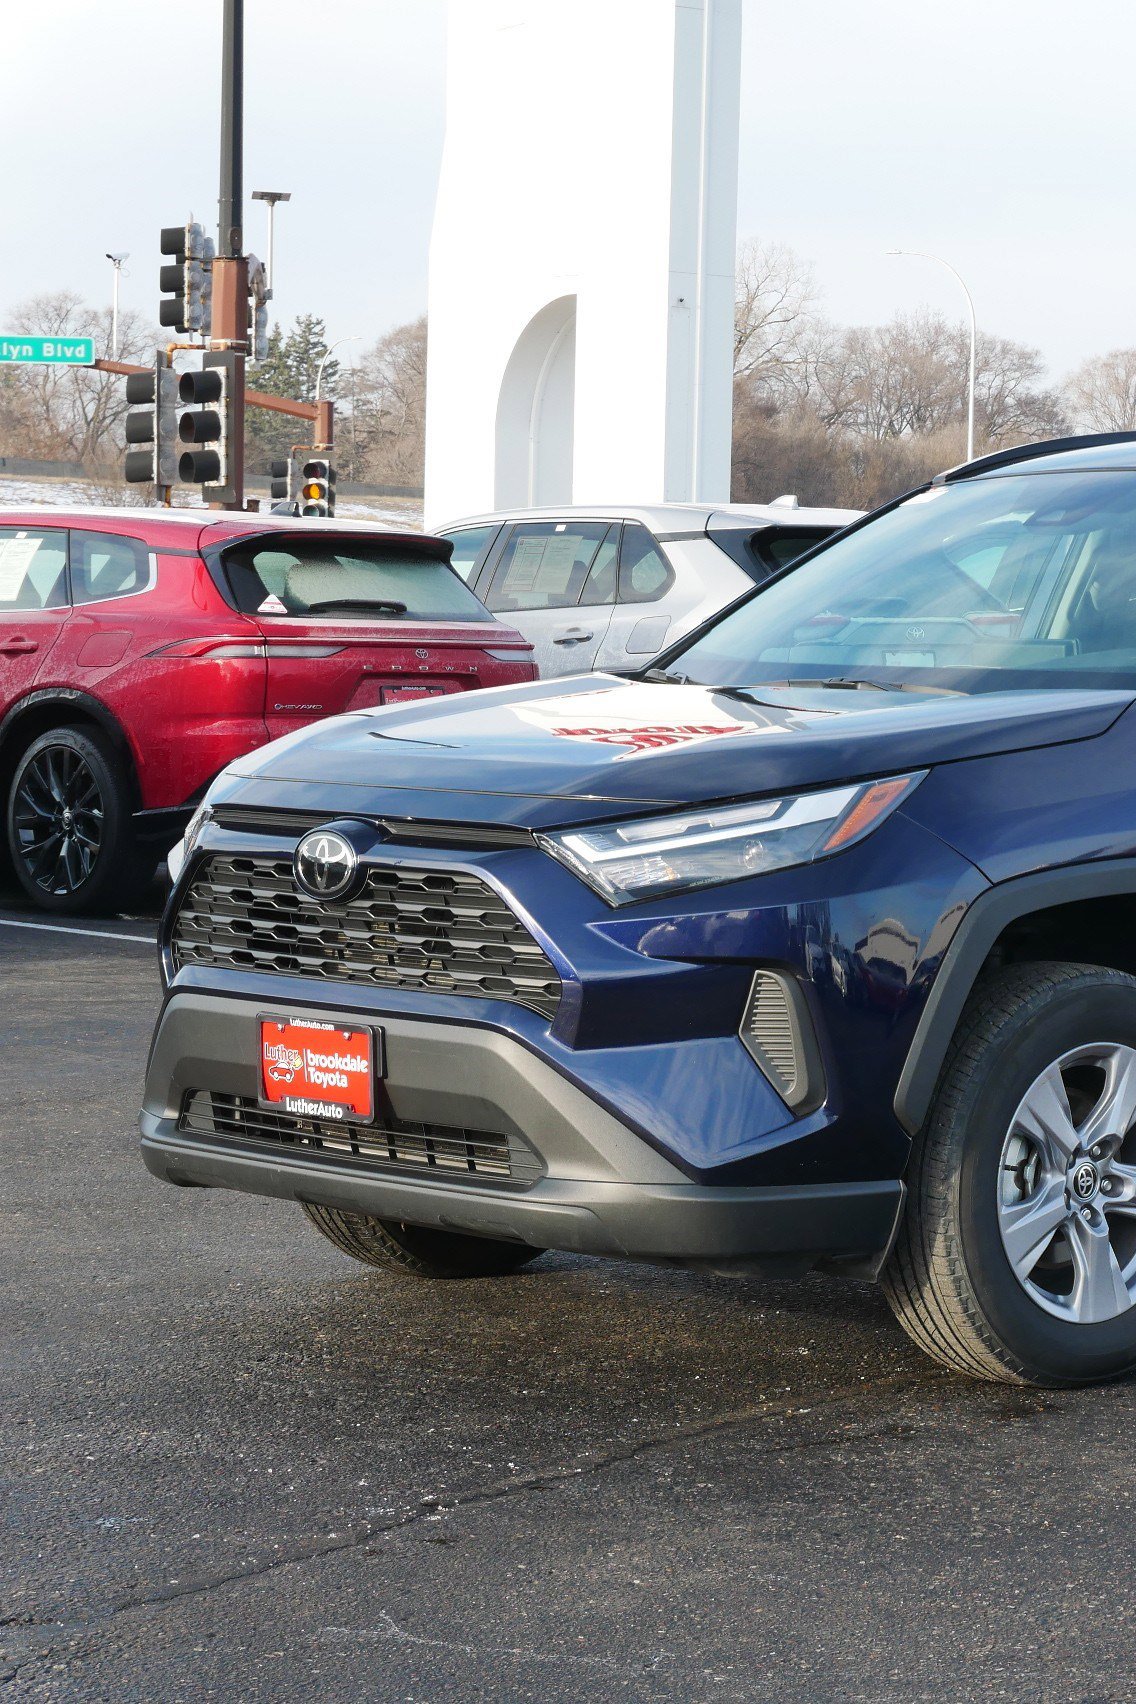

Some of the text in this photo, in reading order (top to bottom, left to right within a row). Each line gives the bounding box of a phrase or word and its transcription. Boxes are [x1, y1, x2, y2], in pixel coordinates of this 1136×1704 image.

[0, 342, 86, 359] lyn Blvd
[289, 1018, 335, 1032] LutherAuto.com
[264, 1042, 299, 1062] Luther
[307, 1049, 369, 1073] brookdale
[308, 1067, 349, 1089] Toyota
[286, 1096, 343, 1119] LutherAuto
